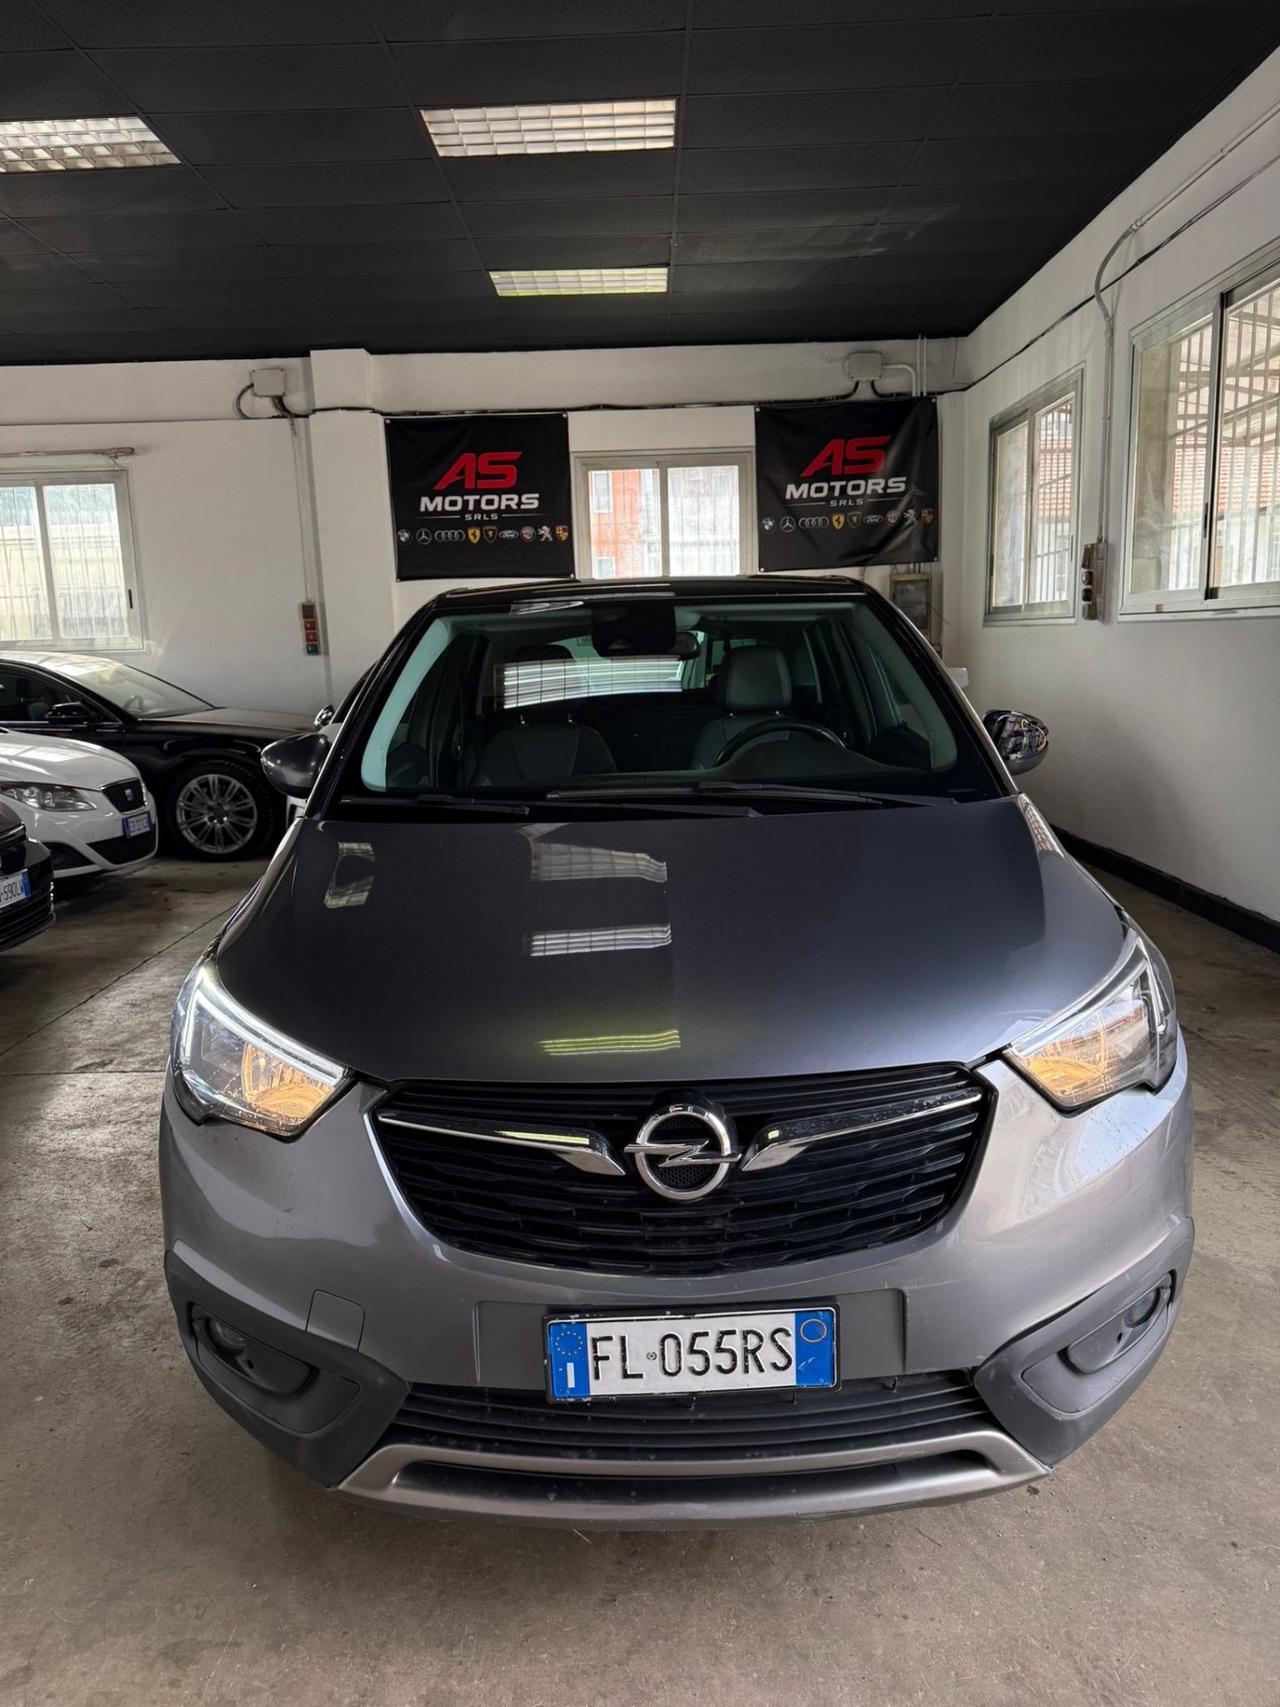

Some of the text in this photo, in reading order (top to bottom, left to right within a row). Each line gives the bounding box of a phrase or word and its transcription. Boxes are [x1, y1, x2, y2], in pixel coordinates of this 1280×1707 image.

[800, 435, 892, 478] AS
[432, 451, 523, 490] AS
[785, 476, 907, 500] MOTORS
[419, 493, 540, 512] MOTORS
[829, 498, 864, 507] SRLS
[464, 513, 498, 521] SRLS
